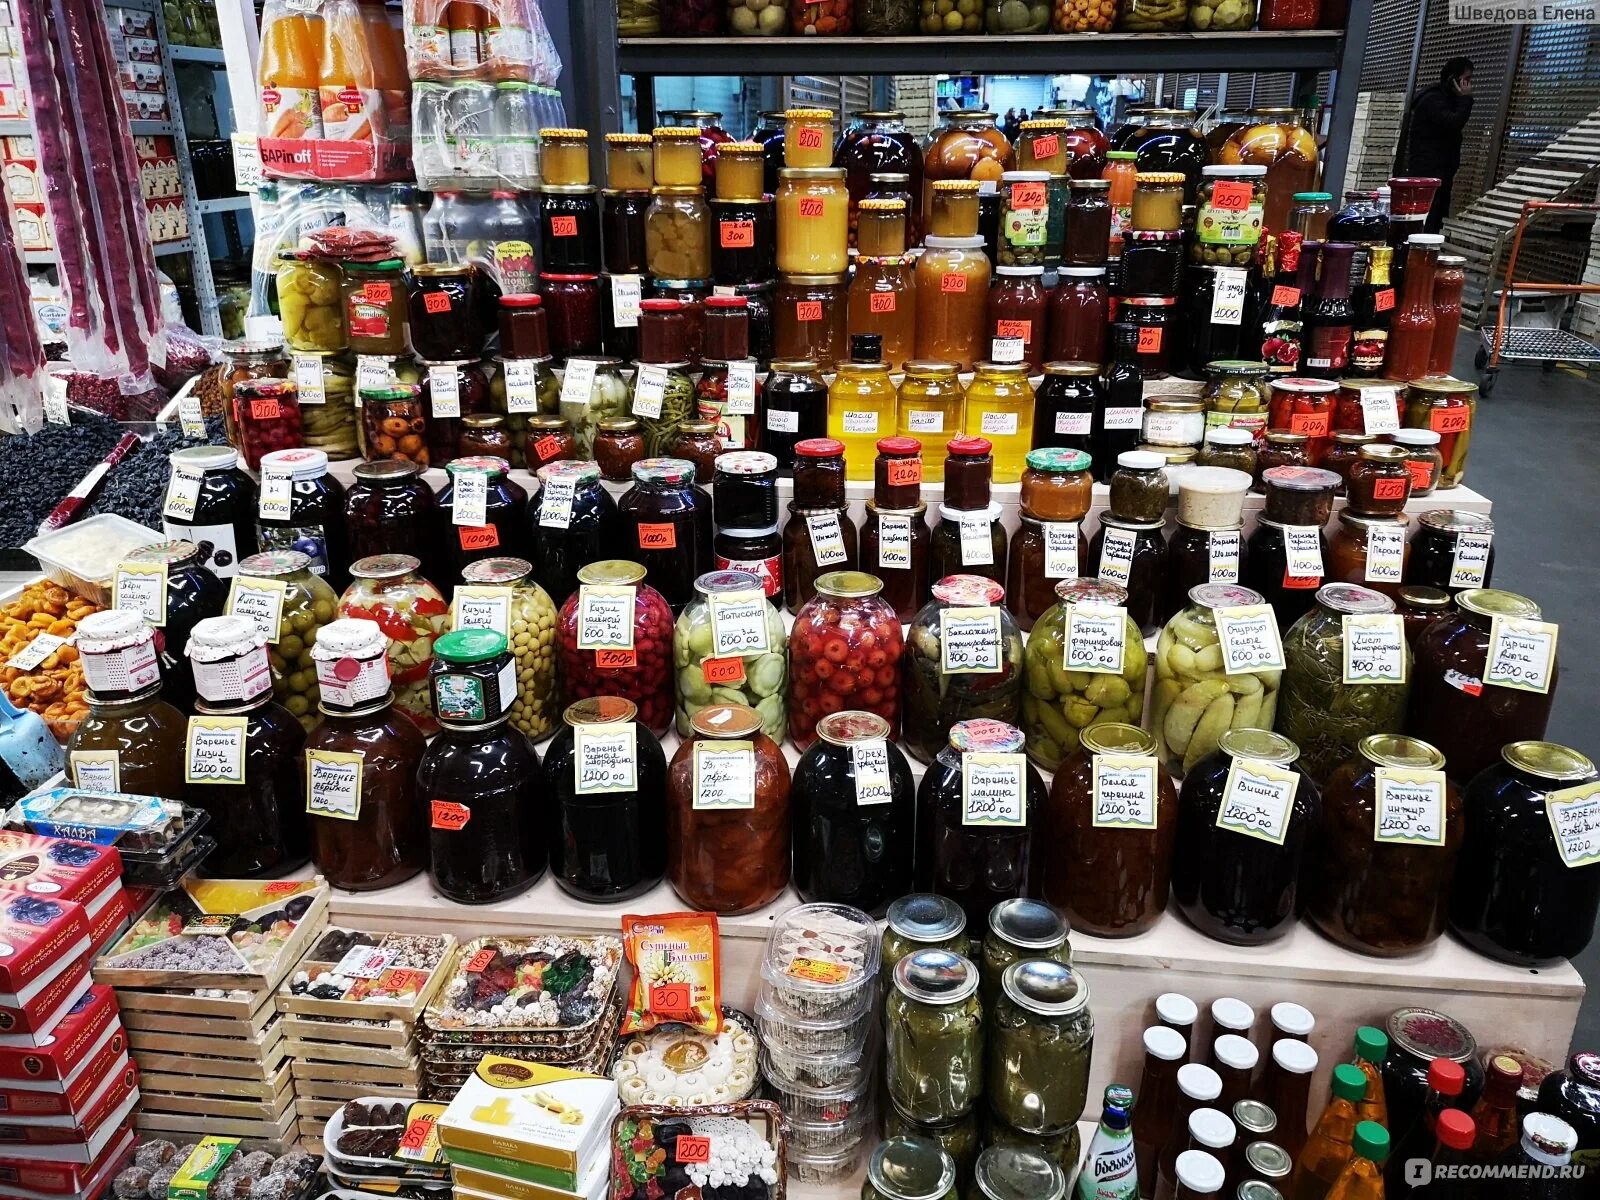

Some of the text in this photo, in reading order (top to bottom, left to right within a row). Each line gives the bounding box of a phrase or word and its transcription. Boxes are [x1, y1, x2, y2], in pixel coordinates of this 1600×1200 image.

[1217, 194, 1242, 207] 250
[727, 231, 746, 241] 300
[1213, 307, 1240, 319] 1000
[1378, 484, 1401, 497] 150
[462, 604, 493, 616] Кизил
[589, 603, 620, 615] Кизил
[1073, 624, 1107, 637] Перец
[1500, 636, 1535, 651] Турши
[601, 651, 632, 665] 700р
[1491, 661, 1522, 677] 1500
[195, 736, 238, 748] Варенье
[584, 744, 627, 757] Варенье
[191, 762, 217, 774] 1200
[581, 770, 610, 782] 1200
[971, 775, 1018, 787] Варенье
[1099, 775, 1138, 788] Белая
[701, 788, 723, 799] 1200
[971, 788, 1016, 798] малина
[1100, 790, 1146, 801] черешня
[1237, 780, 1280, 799] Вишня
[313, 796, 329, 805] 1200
[1385, 790, 1433, 804] Варенье
[968, 801, 996, 814] 1200
[1097, 804, 1125, 816] 1200
[1388, 805, 1425, 817] инжир
[437, 811, 465, 823] 1200
[1224, 806, 1256, 823] 1200
[1380, 818, 1410, 831] 1200
[54, 826, 97, 840] ХАЛВА
[1567, 840, 1592, 855] 1200
[39, 947, 54, 961] COOL
[655, 990, 679, 1008] 30
[680, 1141, 709, 1158] 200
